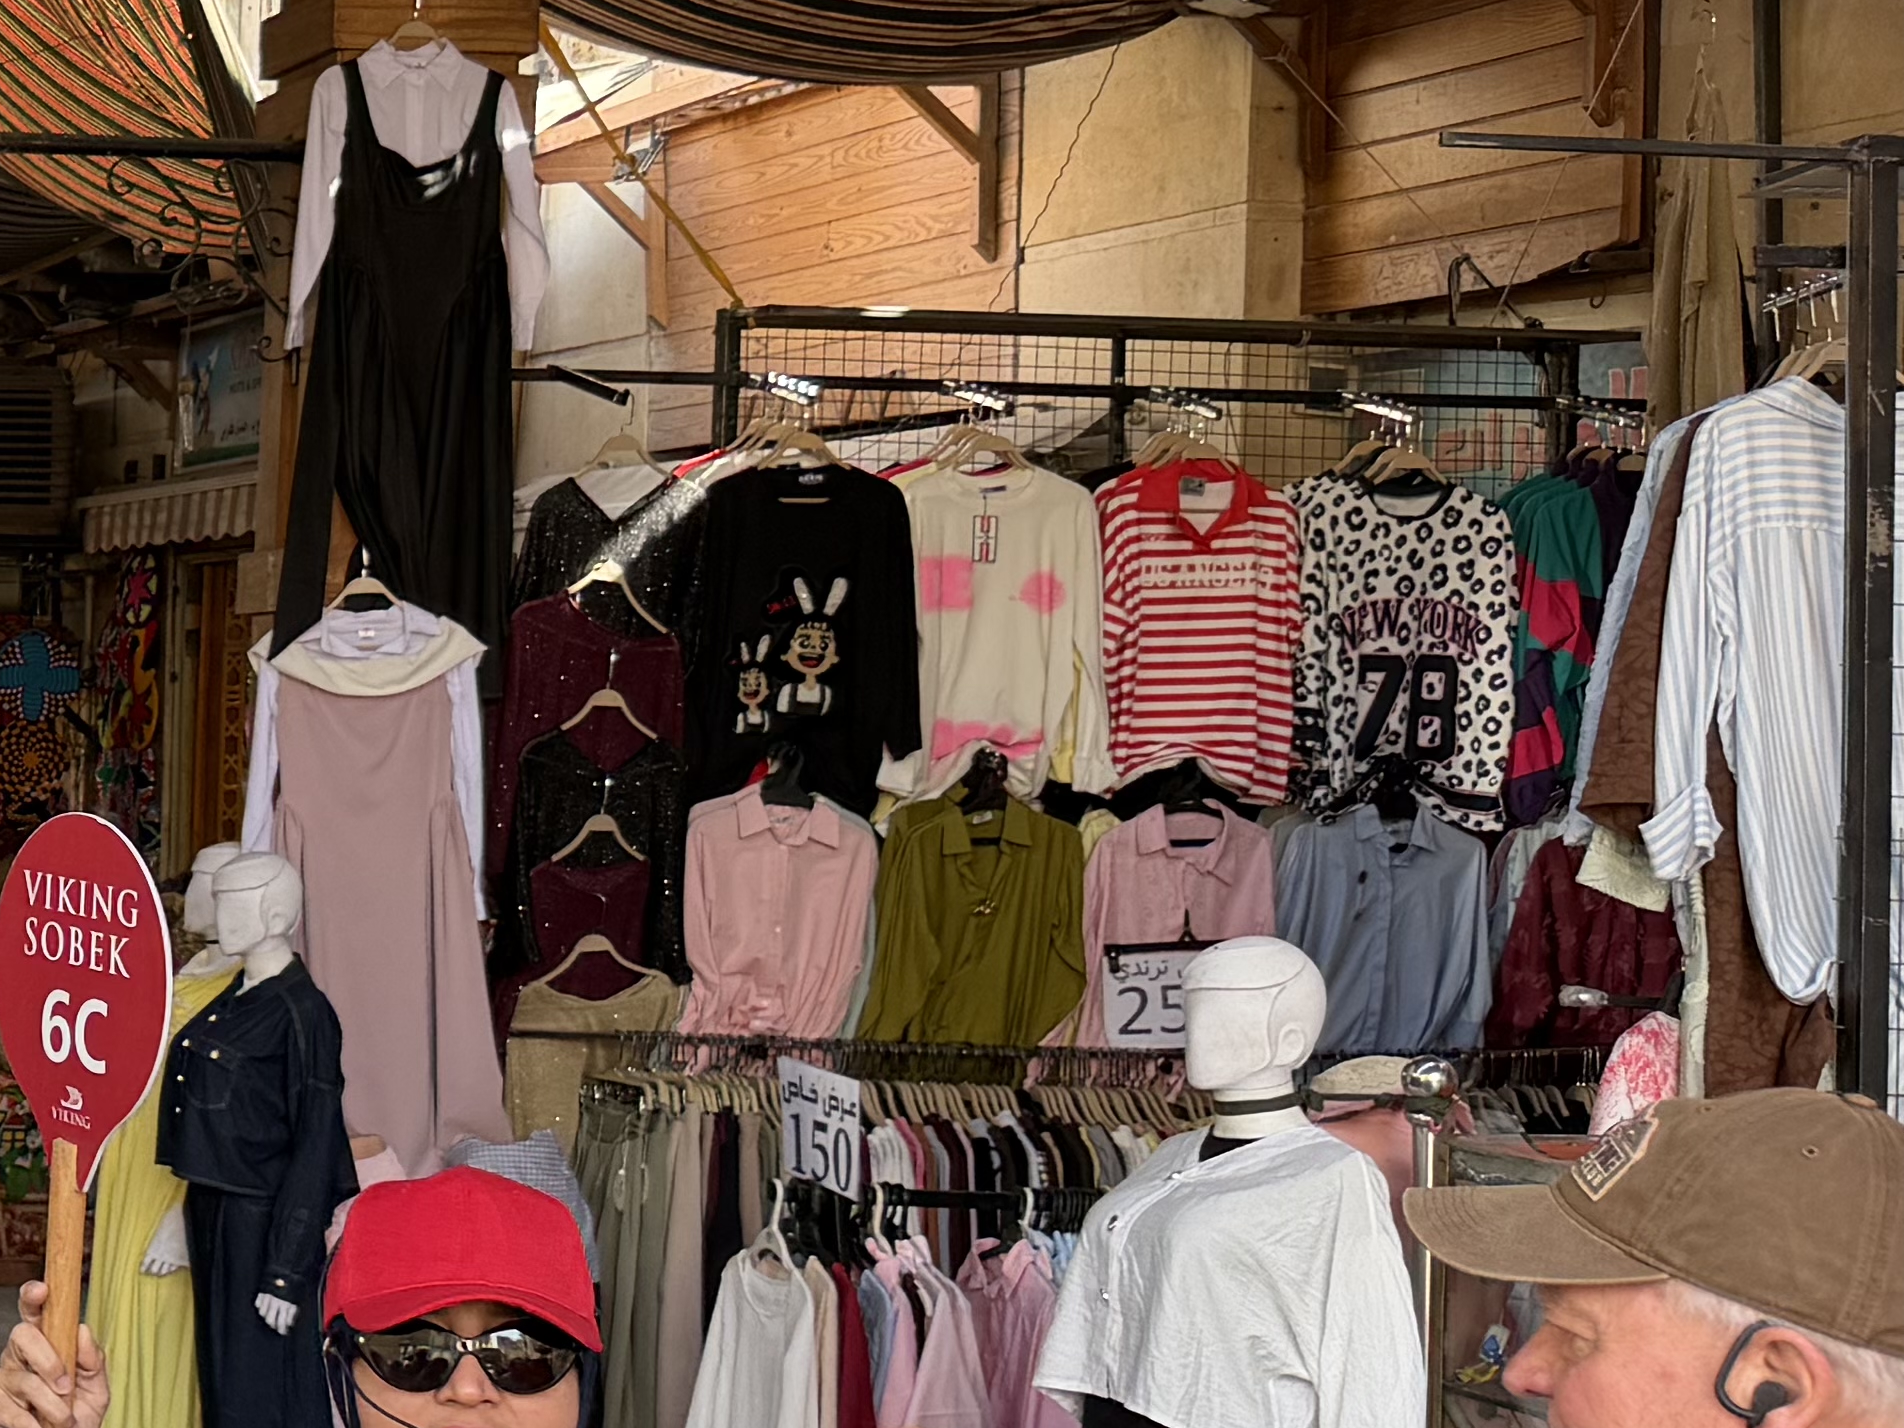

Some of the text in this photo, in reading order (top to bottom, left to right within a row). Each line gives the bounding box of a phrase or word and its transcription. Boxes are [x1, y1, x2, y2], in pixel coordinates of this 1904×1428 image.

[1340, 598, 1482, 660] NEW YORK
[1354, 654, 1459, 765] 78
[23, 869, 139, 928] VIKING
[24, 917, 131, 979] SOBEK
[41, 988, 108, 1075] 6C
[51, 1105, 92, 1130] VIKING
[782, 1075, 818, 1104] خاص
[789, 1112, 852, 1192] 150
